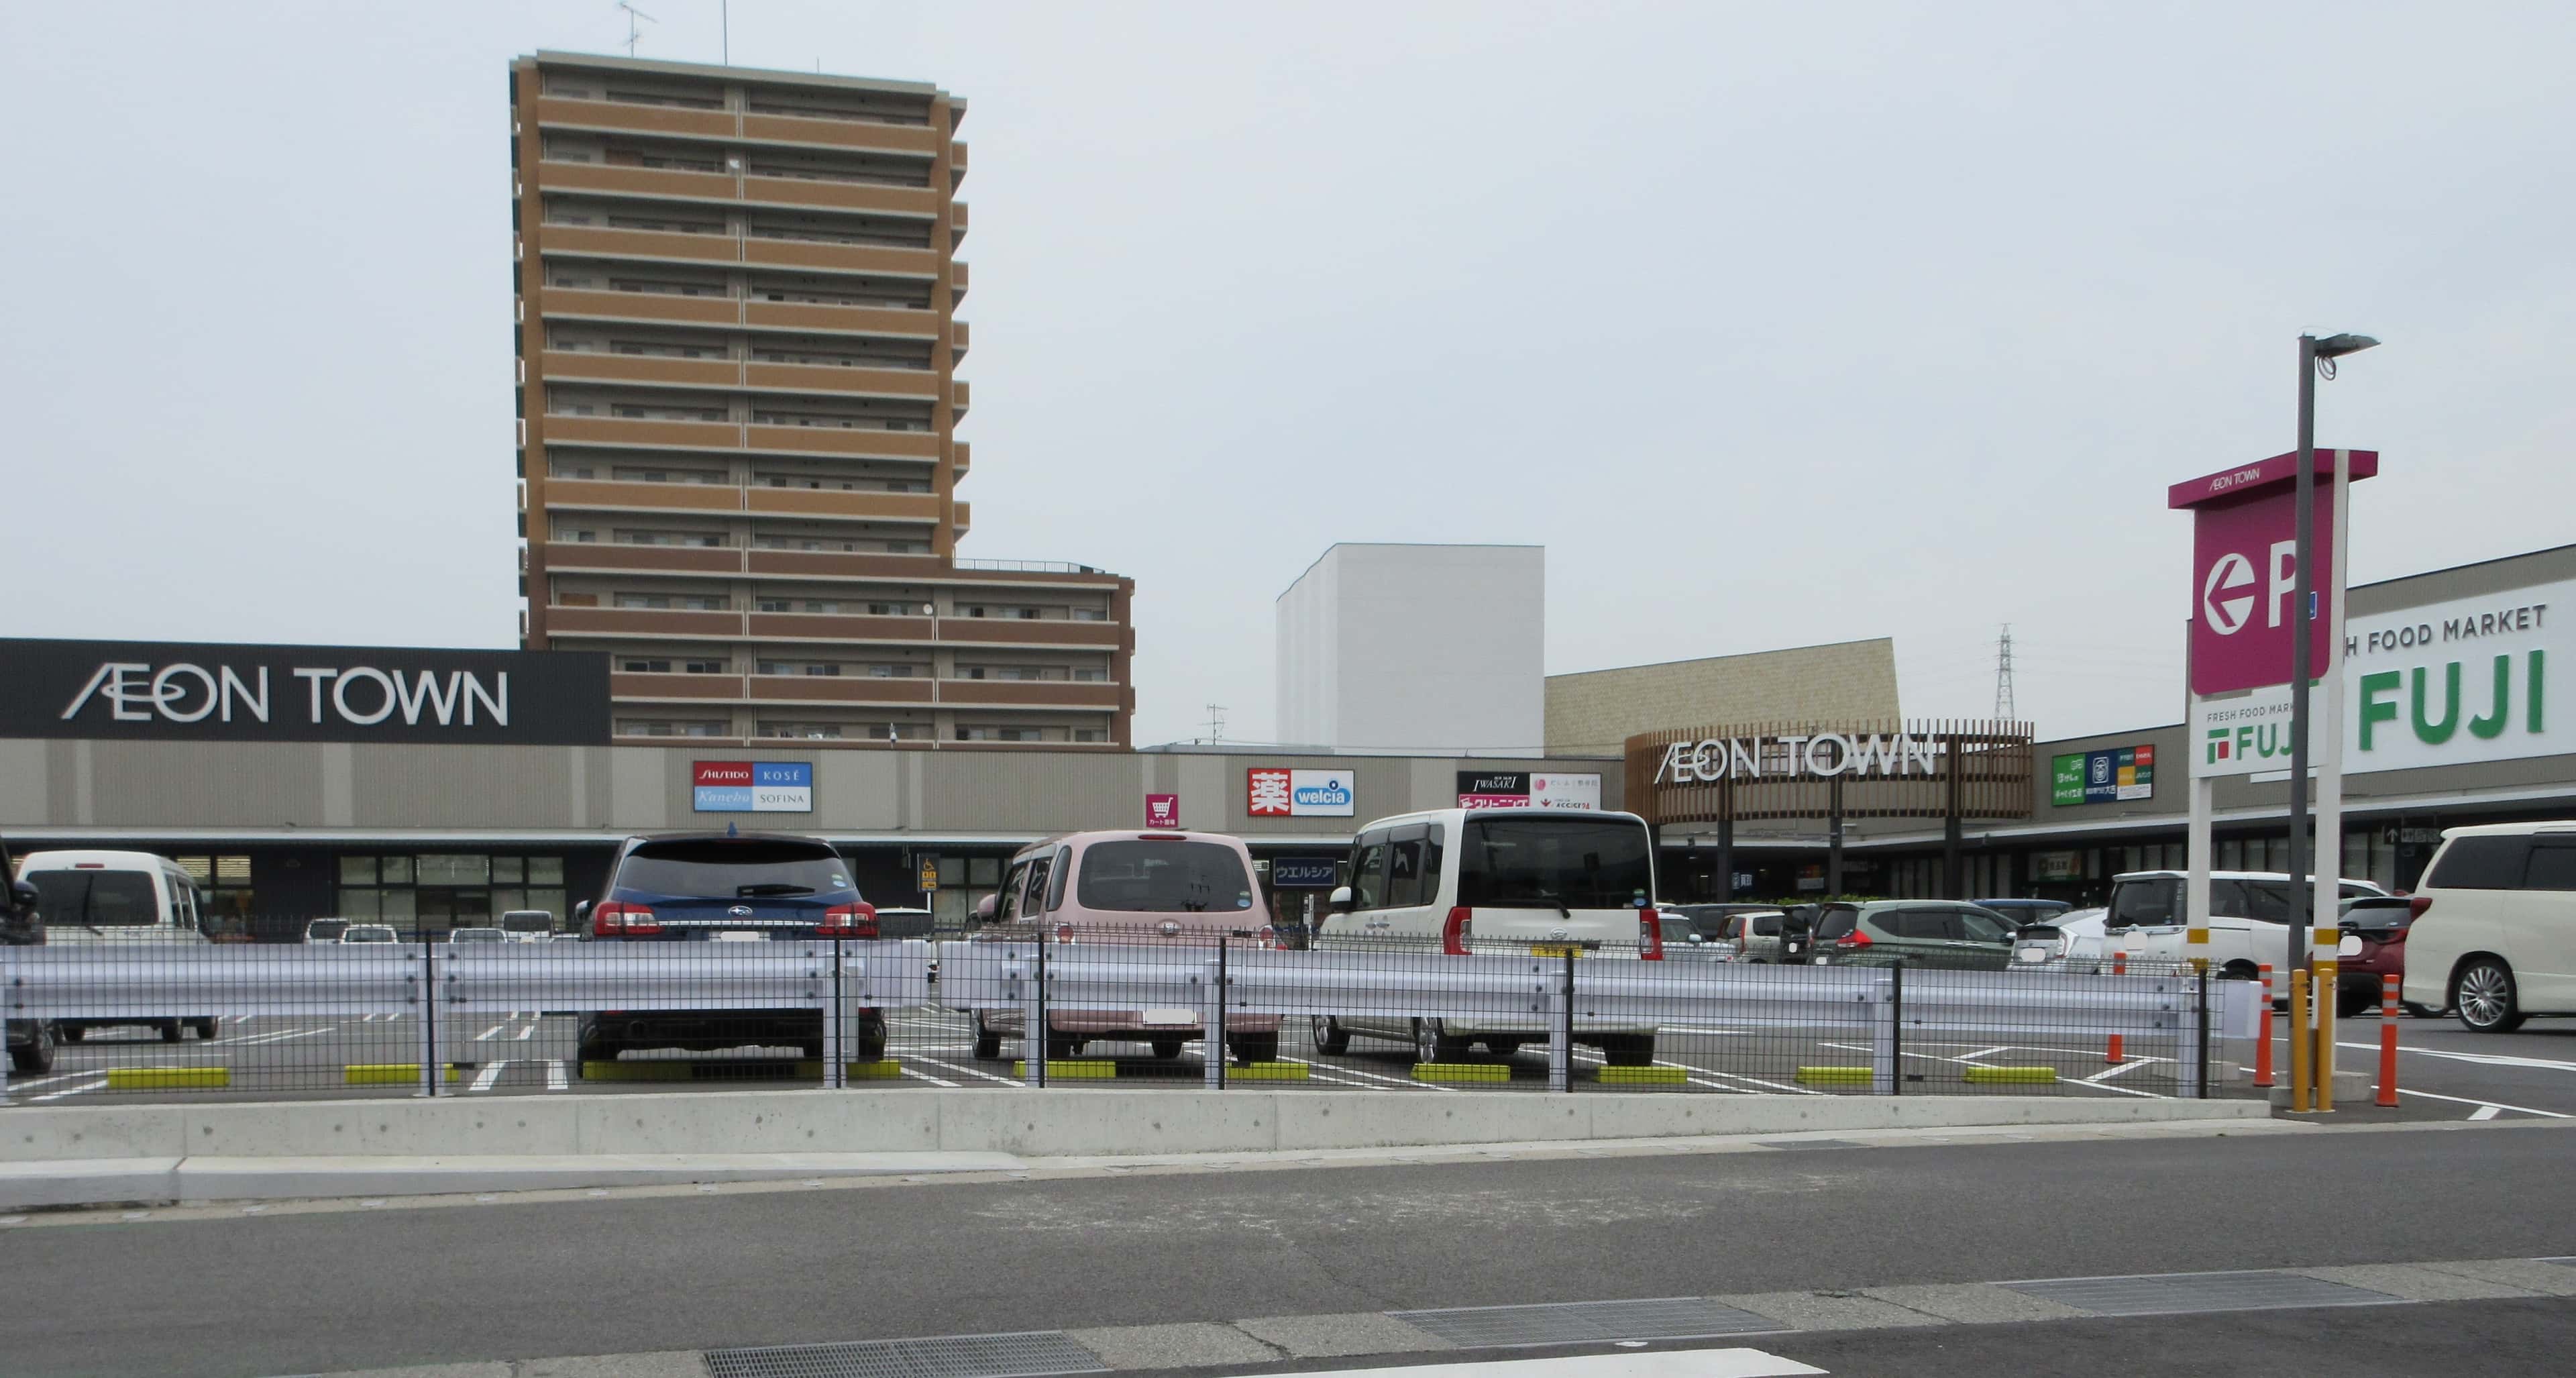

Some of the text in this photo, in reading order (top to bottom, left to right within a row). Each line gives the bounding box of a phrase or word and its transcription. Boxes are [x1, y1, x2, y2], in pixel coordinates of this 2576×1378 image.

[2234, 468, 2259, 484] TOWN
[2268, 540, 2296, 628] P
[2368, 624, 2432, 653] FOOD
[2443, 604, 2546, 642] MARKET
[294, 666, 508, 726] TOWN
[2359, 649, 2544, 751] FUJI
[2207, 702, 2294, 723] FRESH FOOD MAR
[2237, 721, 2294, 761] FUJ
[1778, 733, 1934, 777] TOWN
[699, 770, 749, 779] SHISEIDO
[763, 770, 800, 781] KOSÉ
[1472, 776, 1517, 792] IWASAKI
[698, 790, 750, 803] Kanebo
[760, 794, 804, 803] SOFINA
[1250, 772, 1290, 812] 薬
[1298, 780, 1346, 804] welcia
[1276, 866, 1334, 878] ウエルシア
